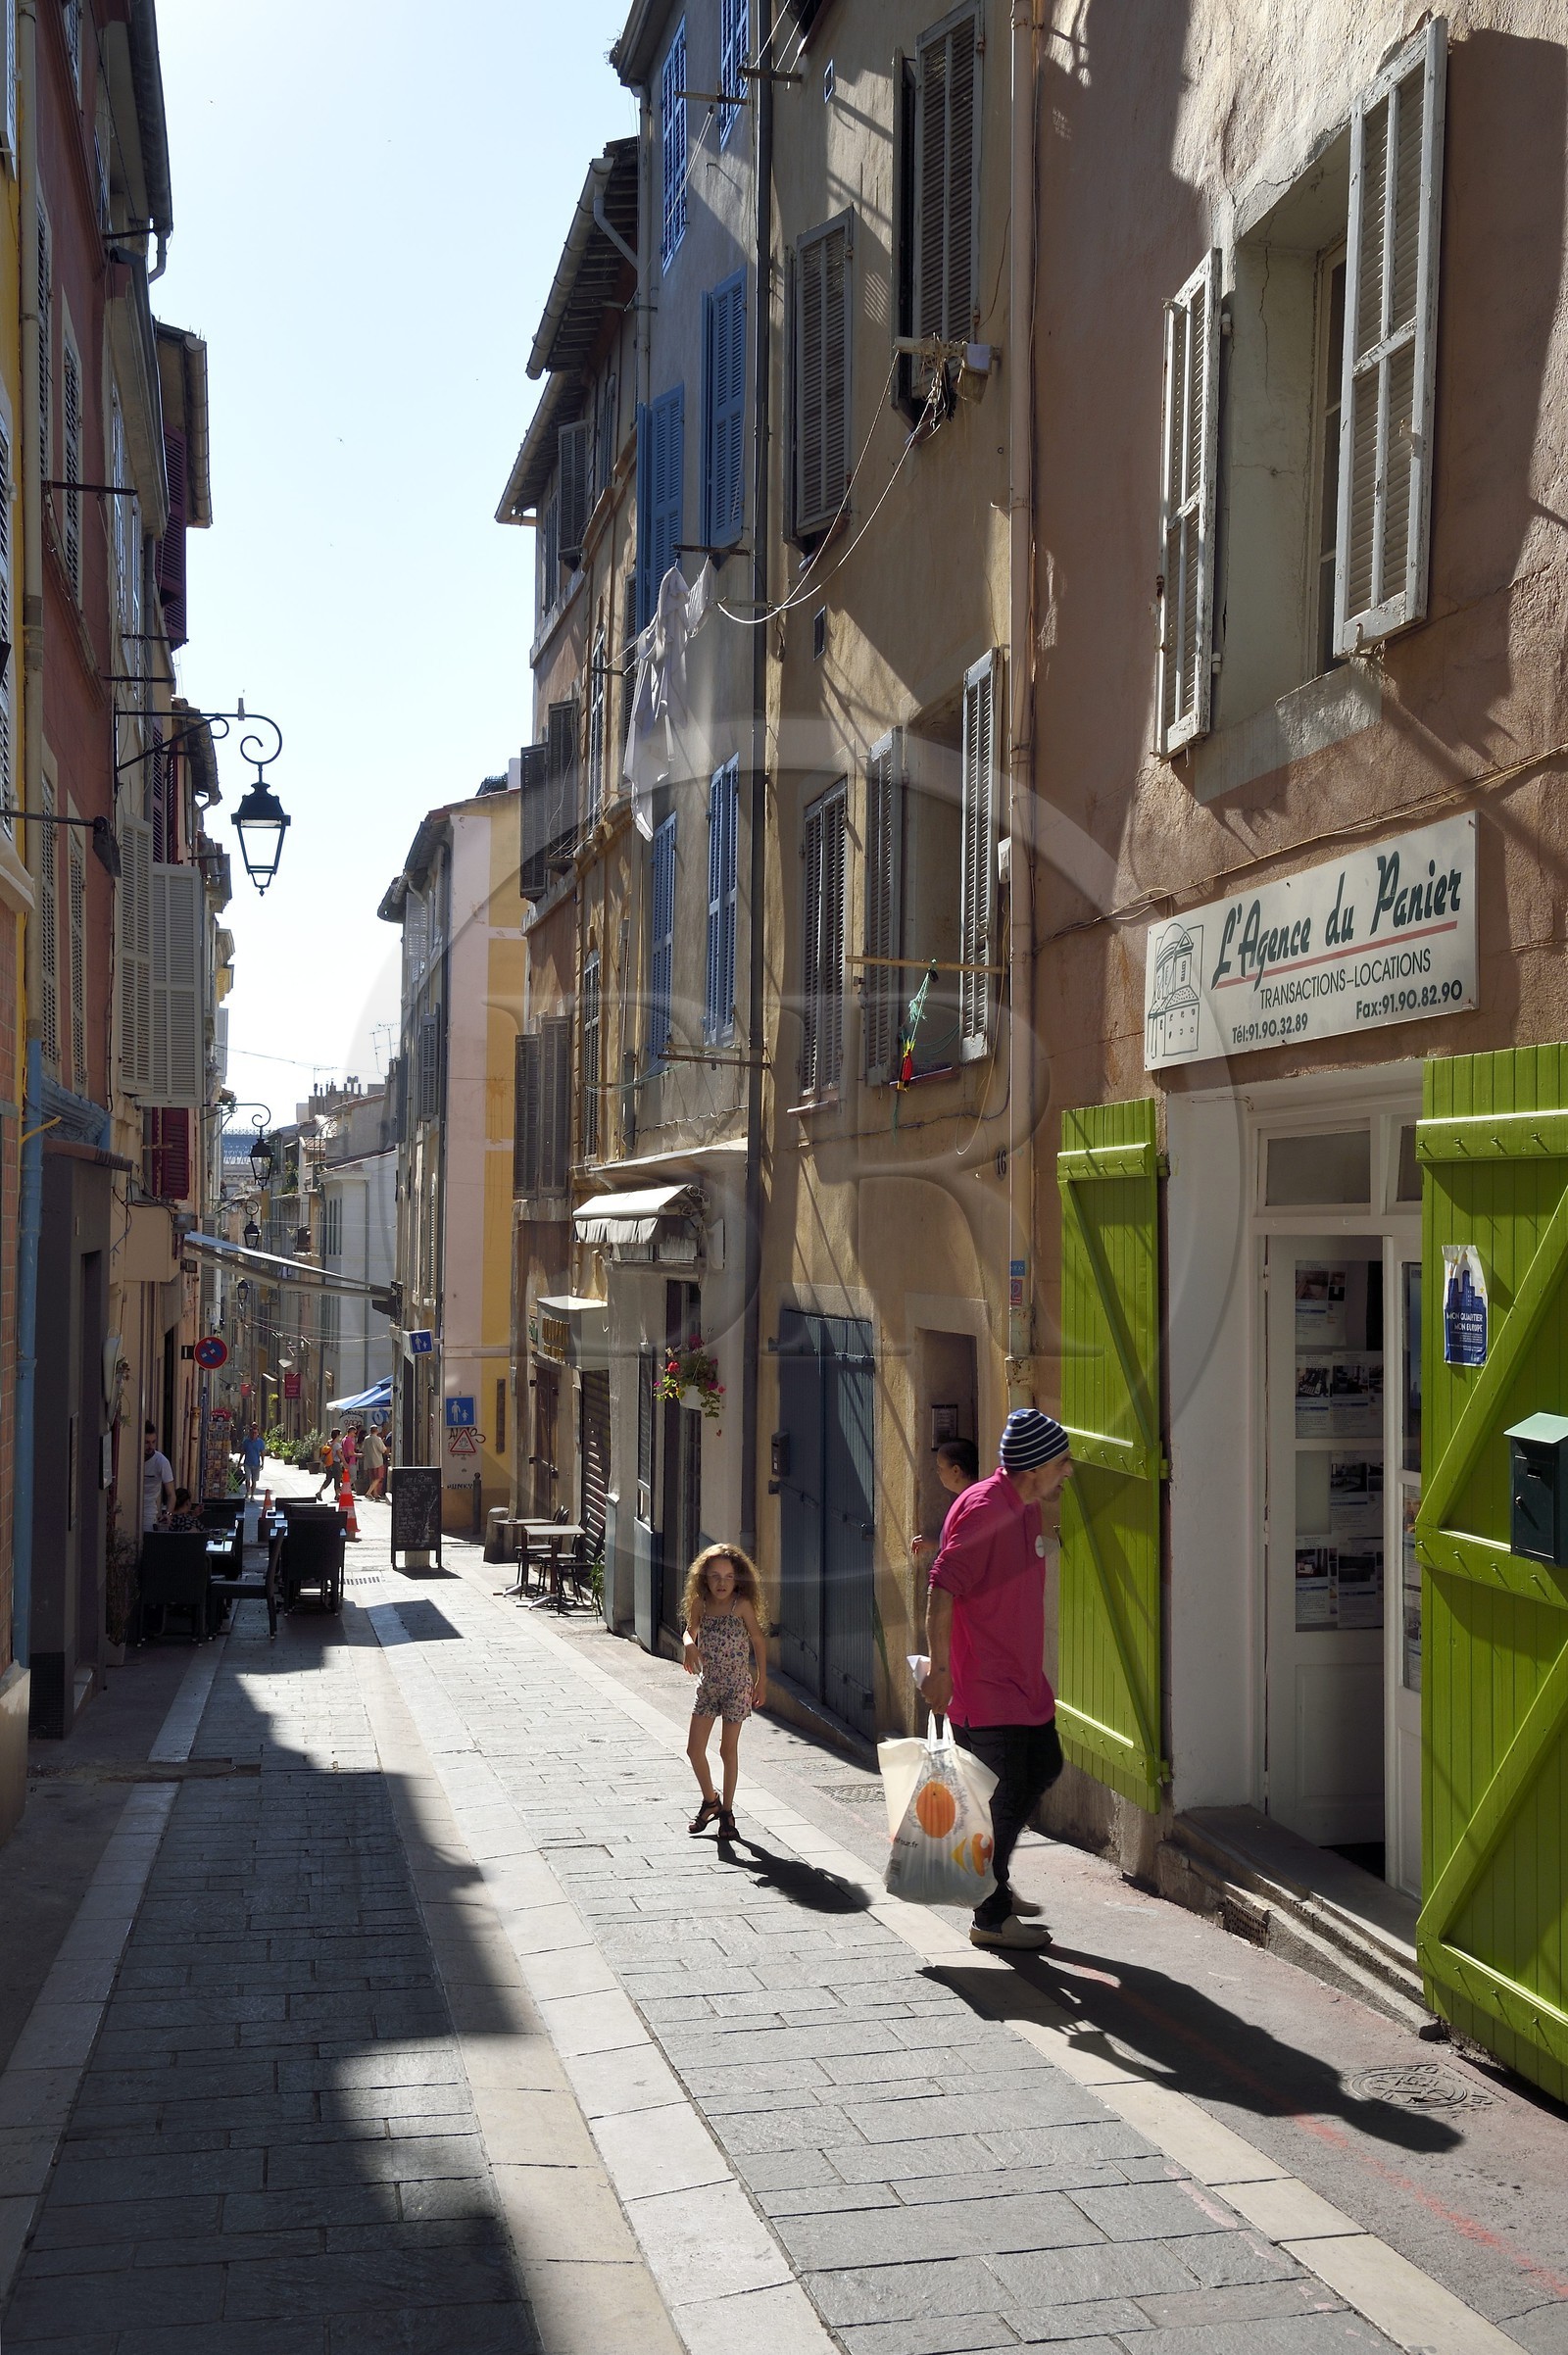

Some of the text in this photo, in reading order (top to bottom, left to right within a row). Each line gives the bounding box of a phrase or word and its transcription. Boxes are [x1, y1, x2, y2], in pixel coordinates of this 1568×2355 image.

[1211, 850, 1462, 992] L'Agence du Panier
[1355, 979, 1463, 1020] Fax:91.90.82.90
[997, 1150, 1007, 1175] 16
[1460, 1313, 1483, 1322] QUARTIER
